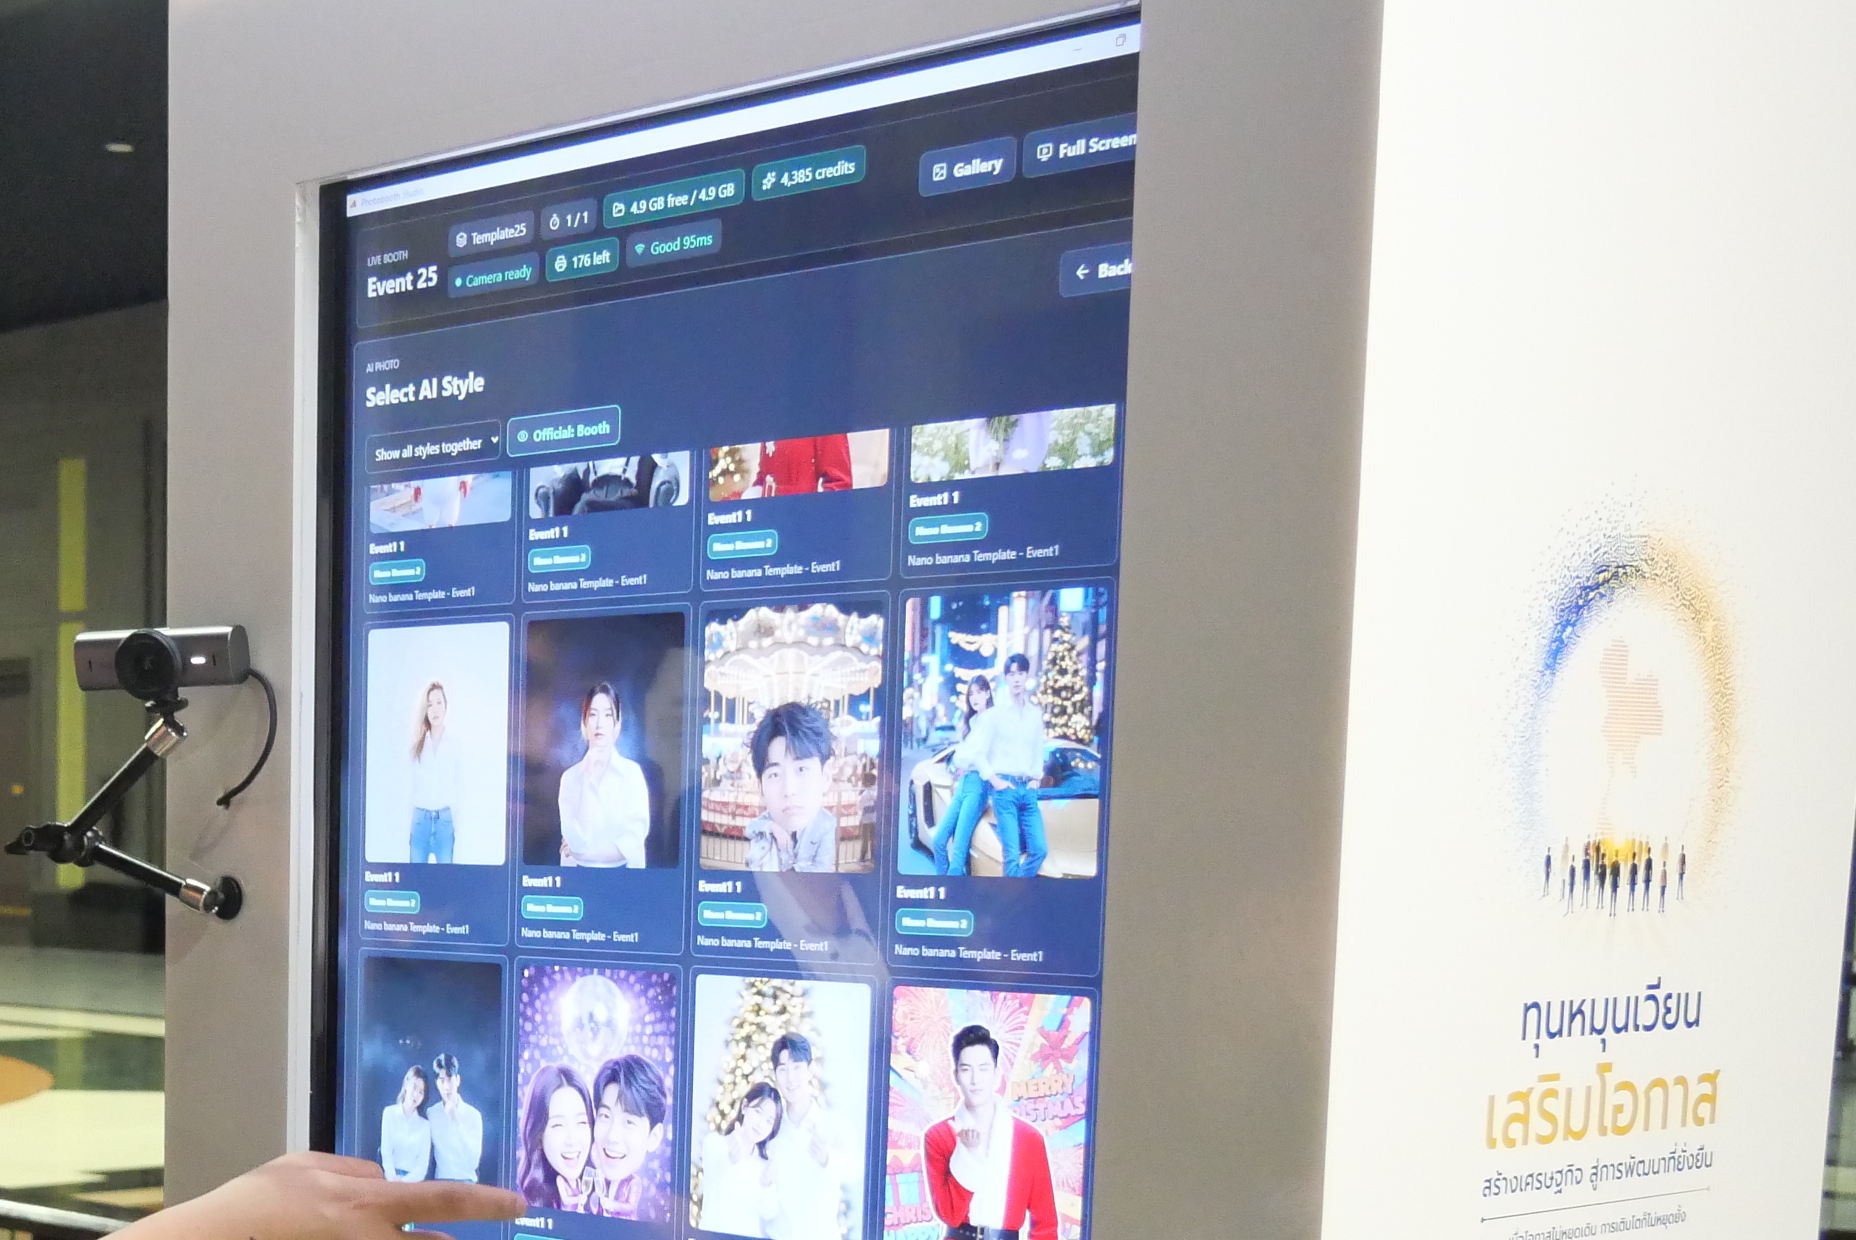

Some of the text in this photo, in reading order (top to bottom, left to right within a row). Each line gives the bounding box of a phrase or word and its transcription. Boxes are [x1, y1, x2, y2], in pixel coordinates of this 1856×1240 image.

[1059, 134, 1137, 158] Full Screen
[780, 161, 855, 187] 4,385 credits
[953, 158, 1003, 177] Gallery
[630, 201, 646, 215] 4.9
[649, 198, 664, 211] GB
[668, 194, 688, 208] free
[699, 188, 716, 201] 4.9
[718, 183, 734, 198] GB
[472, 223, 526, 245] Template25
[651, 235, 712, 254] Good 95ms
[368, 250, 408, 267] LIVE BOOTH
[573, 250, 610, 268] 176 left
[466, 265, 532, 288] Camera ready
[1098, 259, 1132, 278] Back
[368, 266, 437, 298] Event 25
[366, 359, 399, 373] AI PHOTO
[366, 372, 484, 407] Select AI Style
[533, 421, 609, 442] Official: Booth
[376, 438, 482, 461] Show all styles together
[910, 492, 948, 507] Event1
[708, 511, 742, 524] Event1
[529, 527, 559, 540] Event1
[370, 542, 397, 554] Event1
[908, 555, 932, 566] Nano
[936, 554, 970, 564] banana
[973, 549, 1016, 563] Template
[1027, 545, 1058, 558] Event1
[707, 561, 840, 579] Nano banana Template Event1
[528, 574, 646, 592] Nano banana Template Event1
[369, 587, 474, 603] Nano banana Template Event1
[365, 871, 392, 882] Event1
[523, 876, 552, 887] Event1
[699, 880, 733, 892] Event1
[897, 886, 935, 899] Event1
[365, 920, 468, 934] Nano banana Template Event1
[522, 928, 638, 942] Nano banana Template Event1
[697, 935, 827, 951] Nano banana Template Event1
[895, 944, 919, 955] Nano
[922, 946, 956, 957] banana
[959, 947, 1001, 961] Template
[1011, 950, 1042, 961] Event1
[1521, 977, 1702, 1058] ทุนหมุนเวียน
[1012, 1074, 1075, 1101] MERRY
[1485, 1062, 1721, 1149] เสริมโอกาส
[1482, 1142, 1713, 1197] สร้างเศรษฐกิจ สู่การพัฒนาที่ยั่งยืน
[885, 1204, 934, 1226] CHRIS
